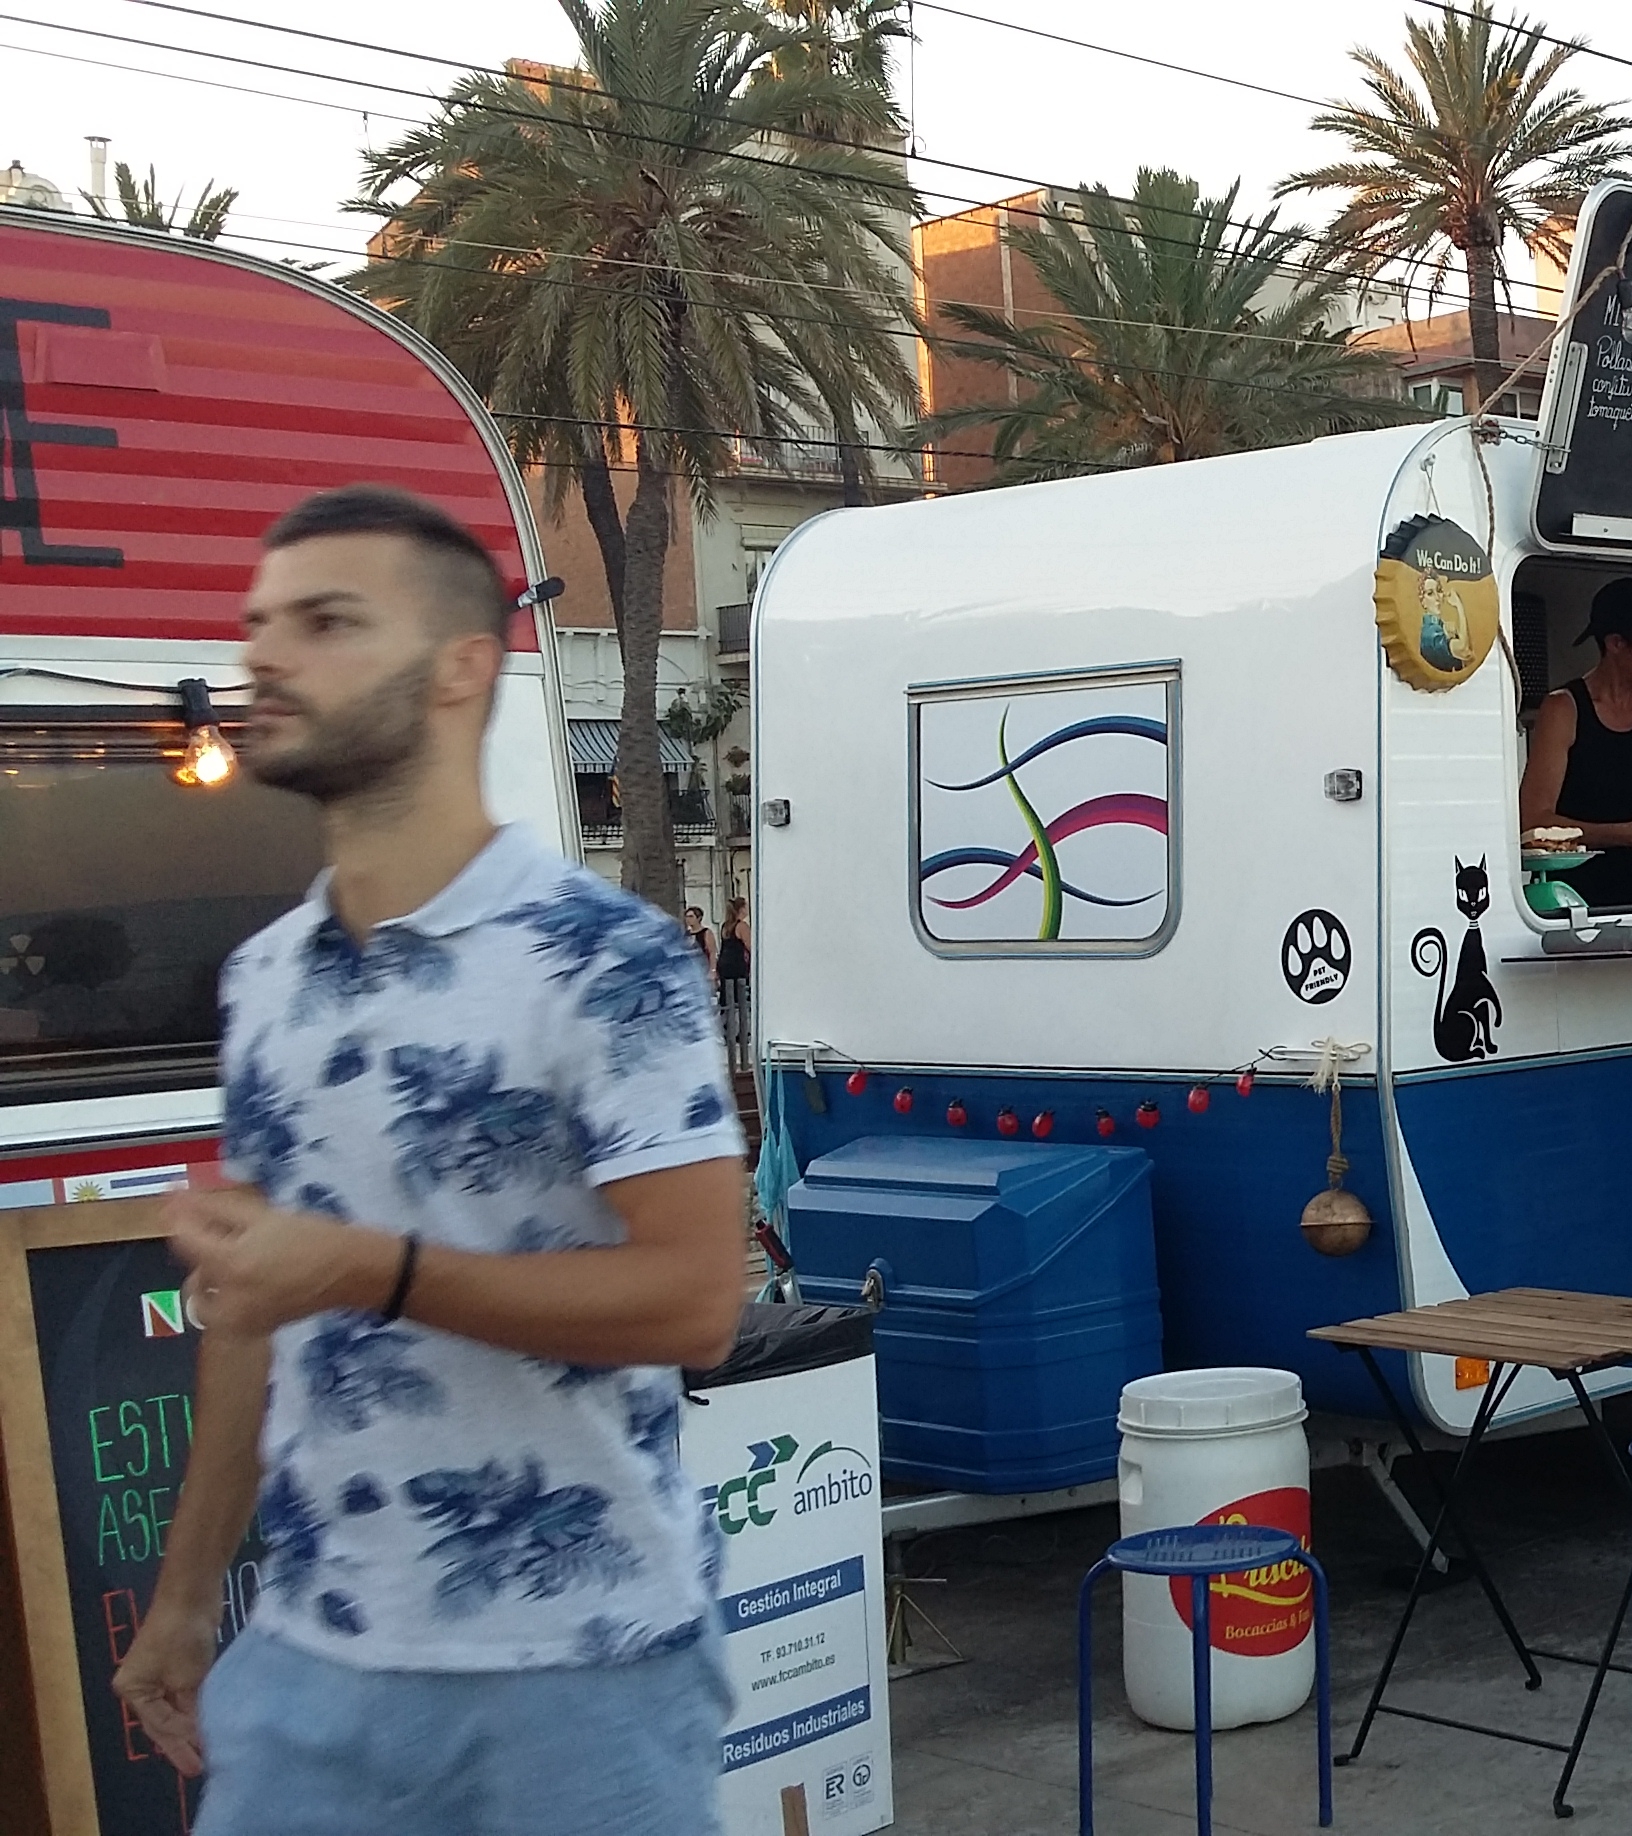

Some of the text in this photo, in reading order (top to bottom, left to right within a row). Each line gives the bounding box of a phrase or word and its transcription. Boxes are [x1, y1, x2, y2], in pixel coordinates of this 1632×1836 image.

[1416, 548, 1481, 574] We Can Do It!
[1305, 973, 1339, 991] FRIENDLY
[1313, 966, 1326, 977] PET
[794, 1469, 873, 1515] ambito
[738, 1569, 841, 1618] Gestión Integral
[1225, 1617, 1288, 1640] Bocaccias
[751, 1653, 836, 1692] www.fccambito.es
[722, 1700, 865, 1765] Residuos Industriales
